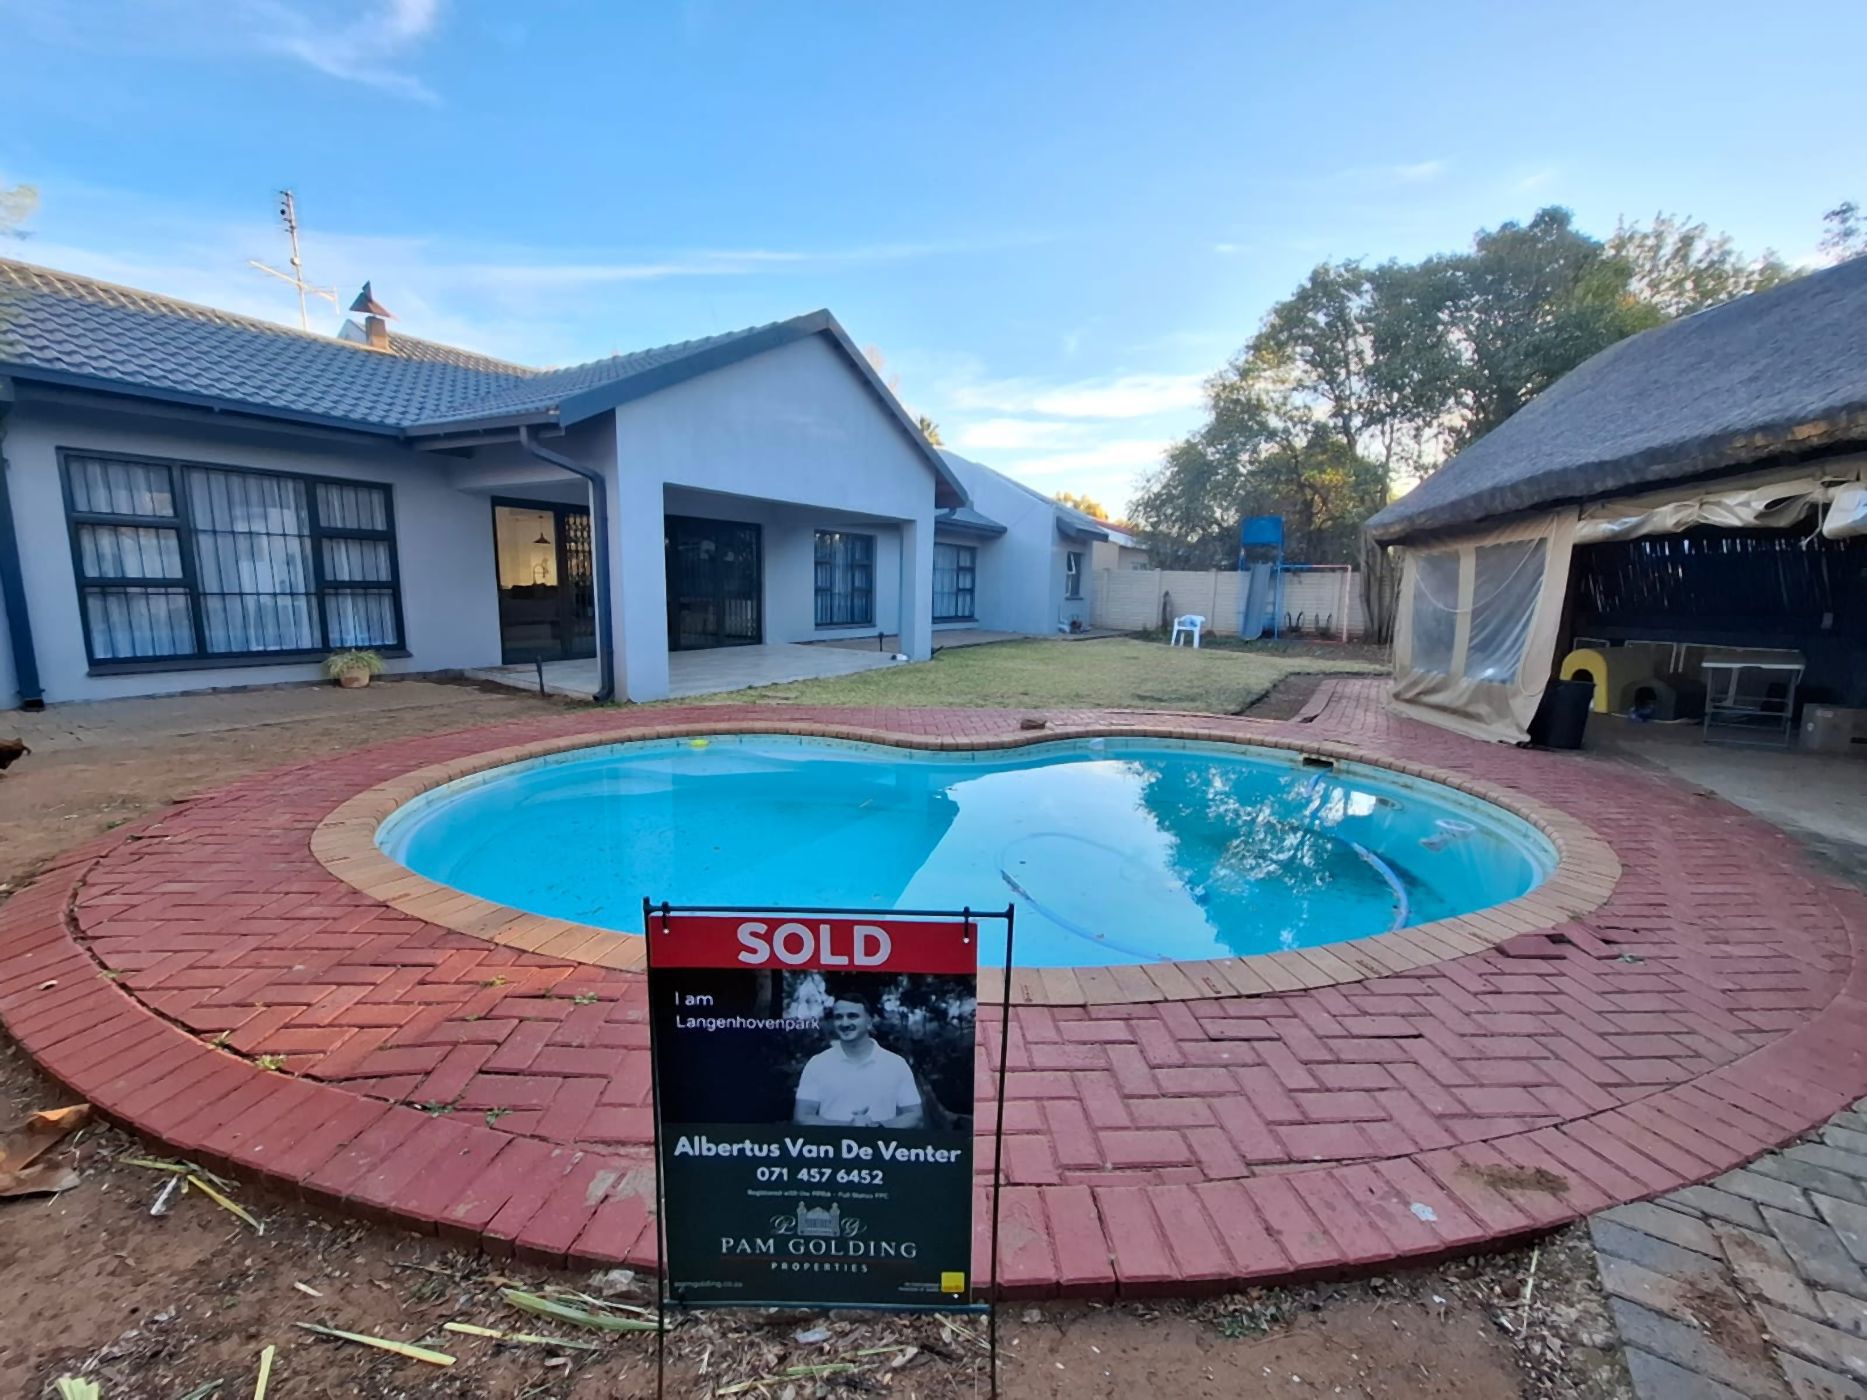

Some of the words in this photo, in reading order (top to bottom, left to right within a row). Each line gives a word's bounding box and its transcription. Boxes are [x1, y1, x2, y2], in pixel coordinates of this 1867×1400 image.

[737, 921, 892, 966] SOLD
[675, 991, 680, 1006] I
[685, 994, 714, 1006] am
[676, 1015, 820, 1032] Langenhovenpark
[674, 1136, 780, 1158] Albertus
[785, 1137, 834, 1159] Van
[842, 1139, 873, 1160] De
[878, 1141, 962, 1163] Venter
[756, 1167, 788, 1181] 071
[797, 1168, 832, 1183] 457
[836, 1169, 884, 1185] 6452
[721, 1237, 775, 1255] PAM
[788, 1238, 917, 1259] GOLDING
[771, 1262, 868, 1273] PROPERTIES
